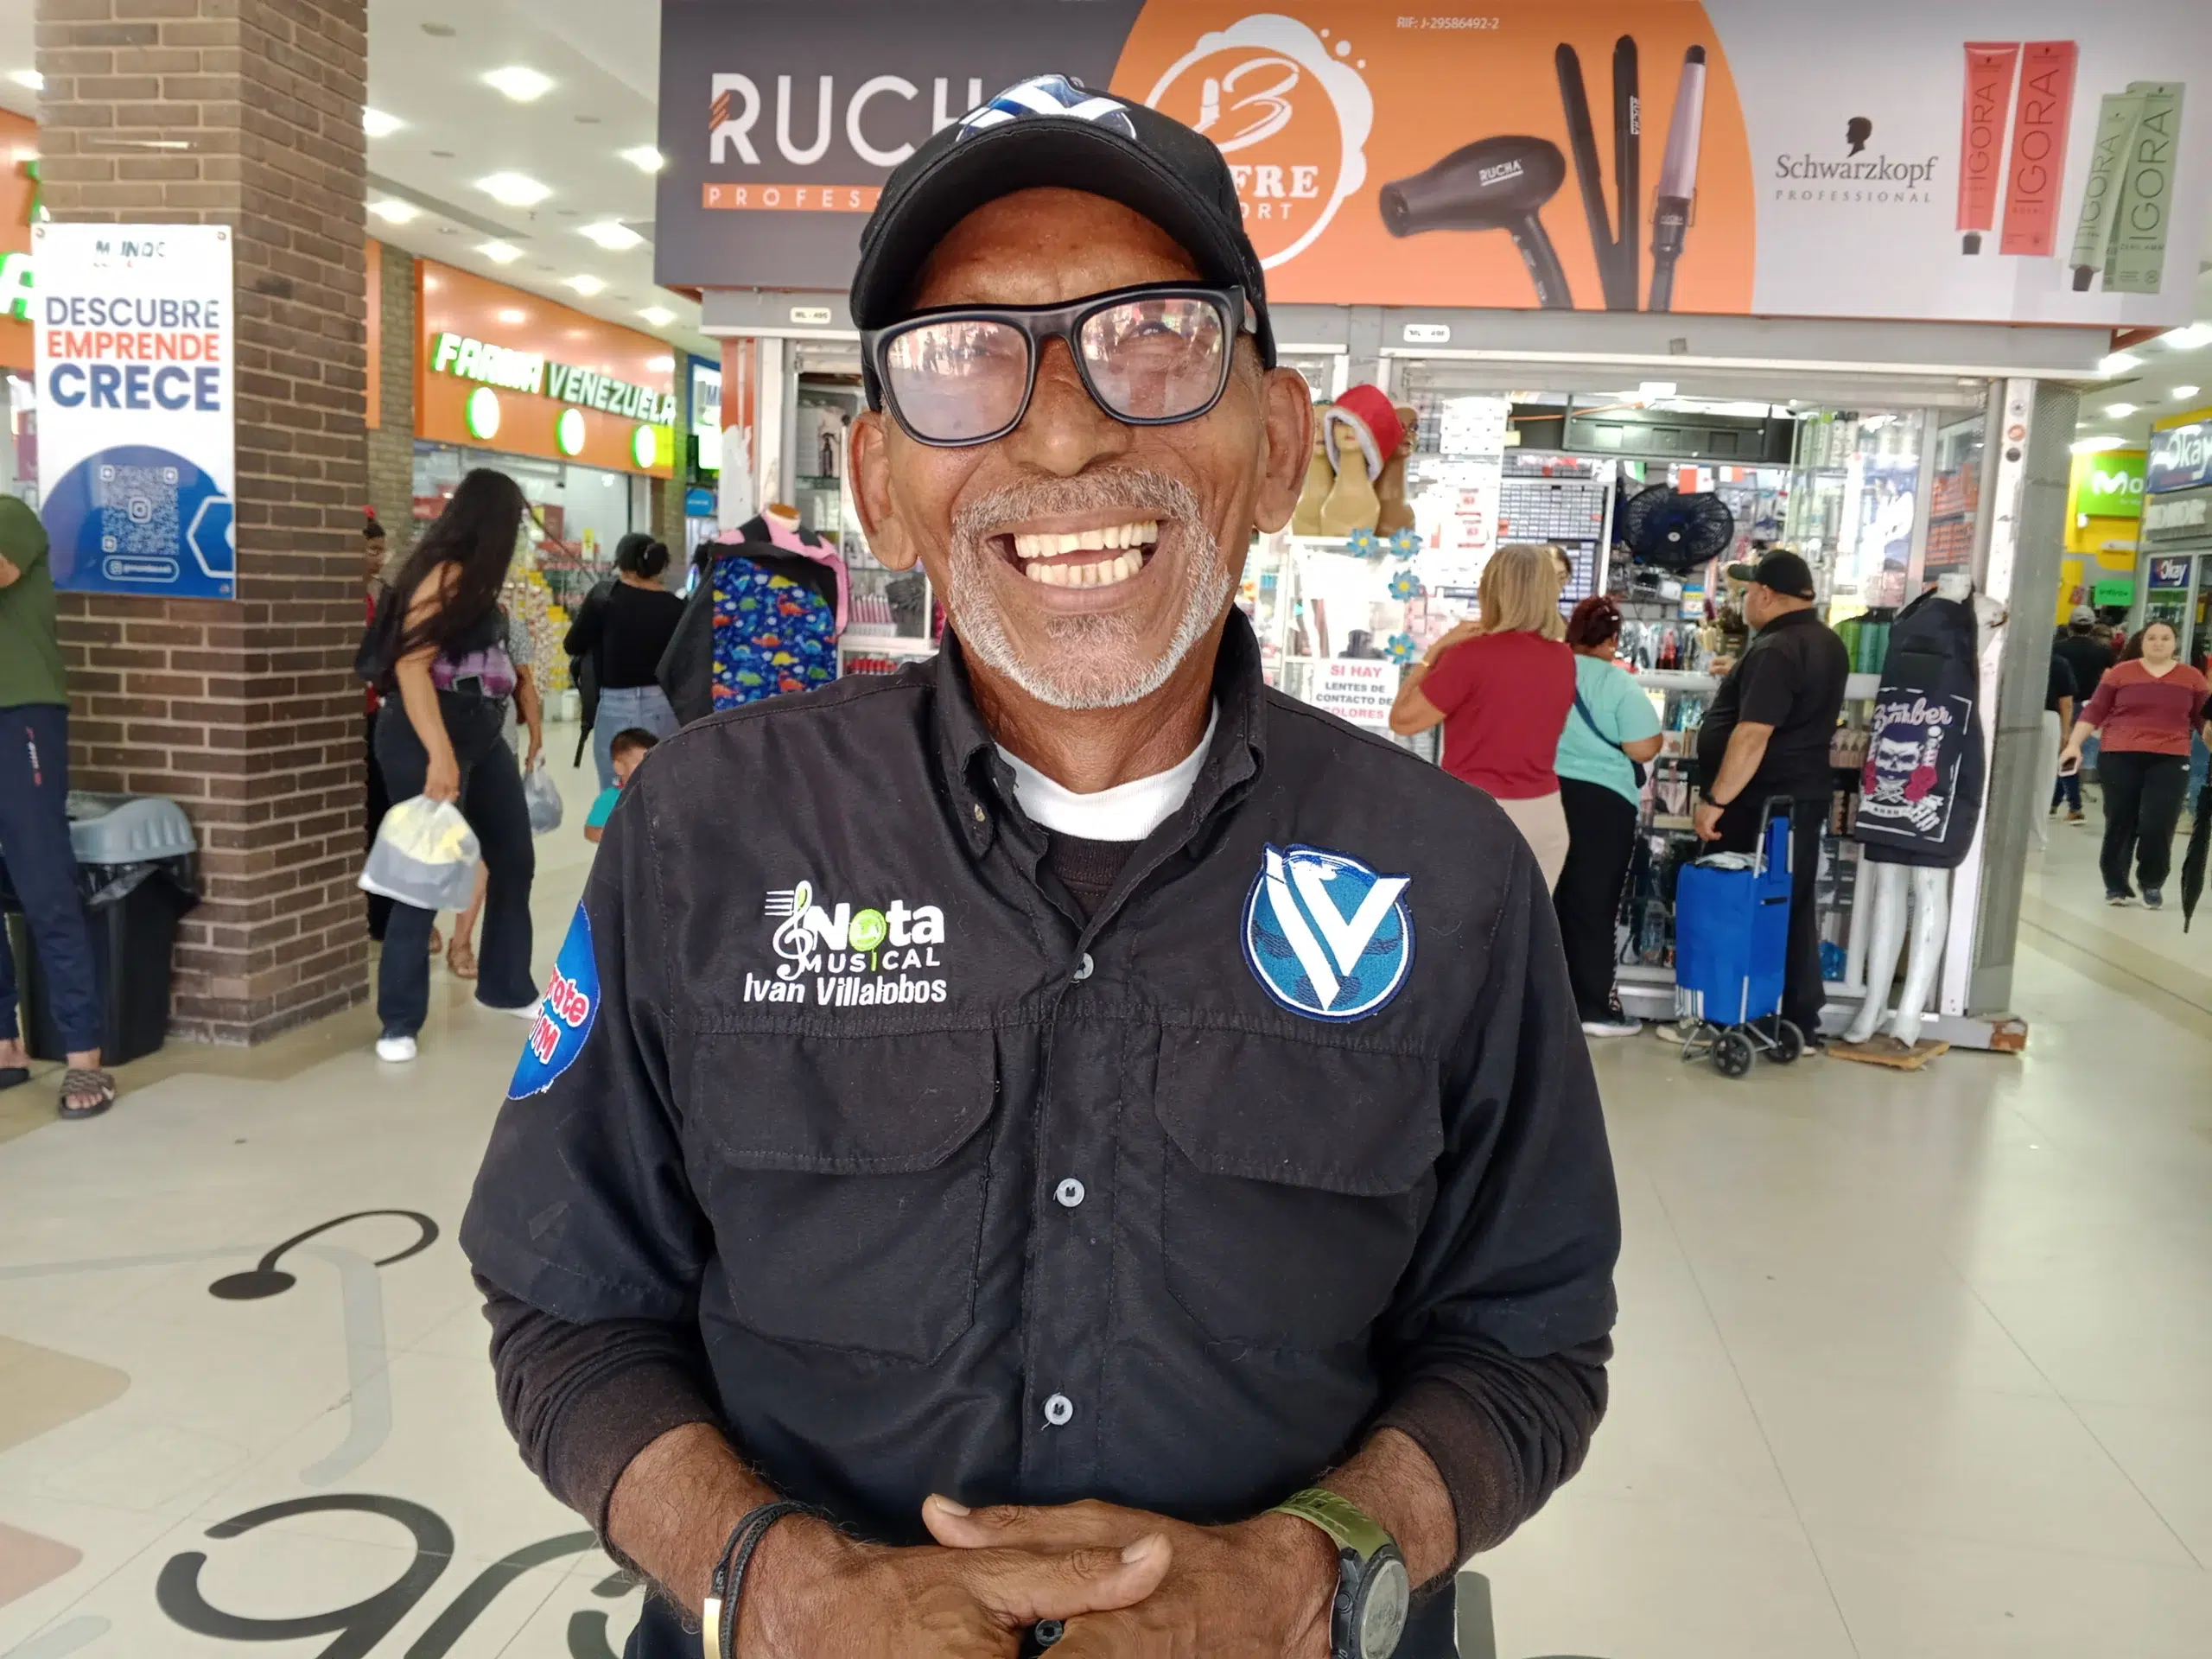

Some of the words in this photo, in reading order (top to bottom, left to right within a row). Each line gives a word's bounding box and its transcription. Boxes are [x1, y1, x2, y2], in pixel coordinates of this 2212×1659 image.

[1420, 16, 1500, 29] J-29586492-2
[709, 73, 982, 167] RUCH
[1967, 82, 1998, 180] IGORA
[2014, 68, 2060, 204] IGORA
[1228, 164, 1319, 198] FRE
[1775, 153, 1940, 189] Schwarzkopf
[2078, 134, 2121, 229] IGORA
[2128, 108, 2174, 240] IGORA
[709, 187, 881, 207] PROFES
[1775, 189, 1932, 203] PROFESSIONAL
[46, 296, 219, 328] DESCUBRE
[48, 330, 220, 361] EMPRENDE
[48, 362, 220, 411] CRECE
[547, 361, 677, 426] VENEZUELA
[1325, 682, 1367, 693] LENTES
[1370, 684, 1385, 693] DE
[1331, 664, 1345, 676] SI
[1351, 665, 1382, 678] HAY
[1316, 693, 1376, 705] CONTACTO
[802, 899, 945, 951] Nota
[801, 947, 940, 975] MUSICAL
[743, 972, 805, 1004] Ivan
[817, 974, 947, 1007] Villalobos
